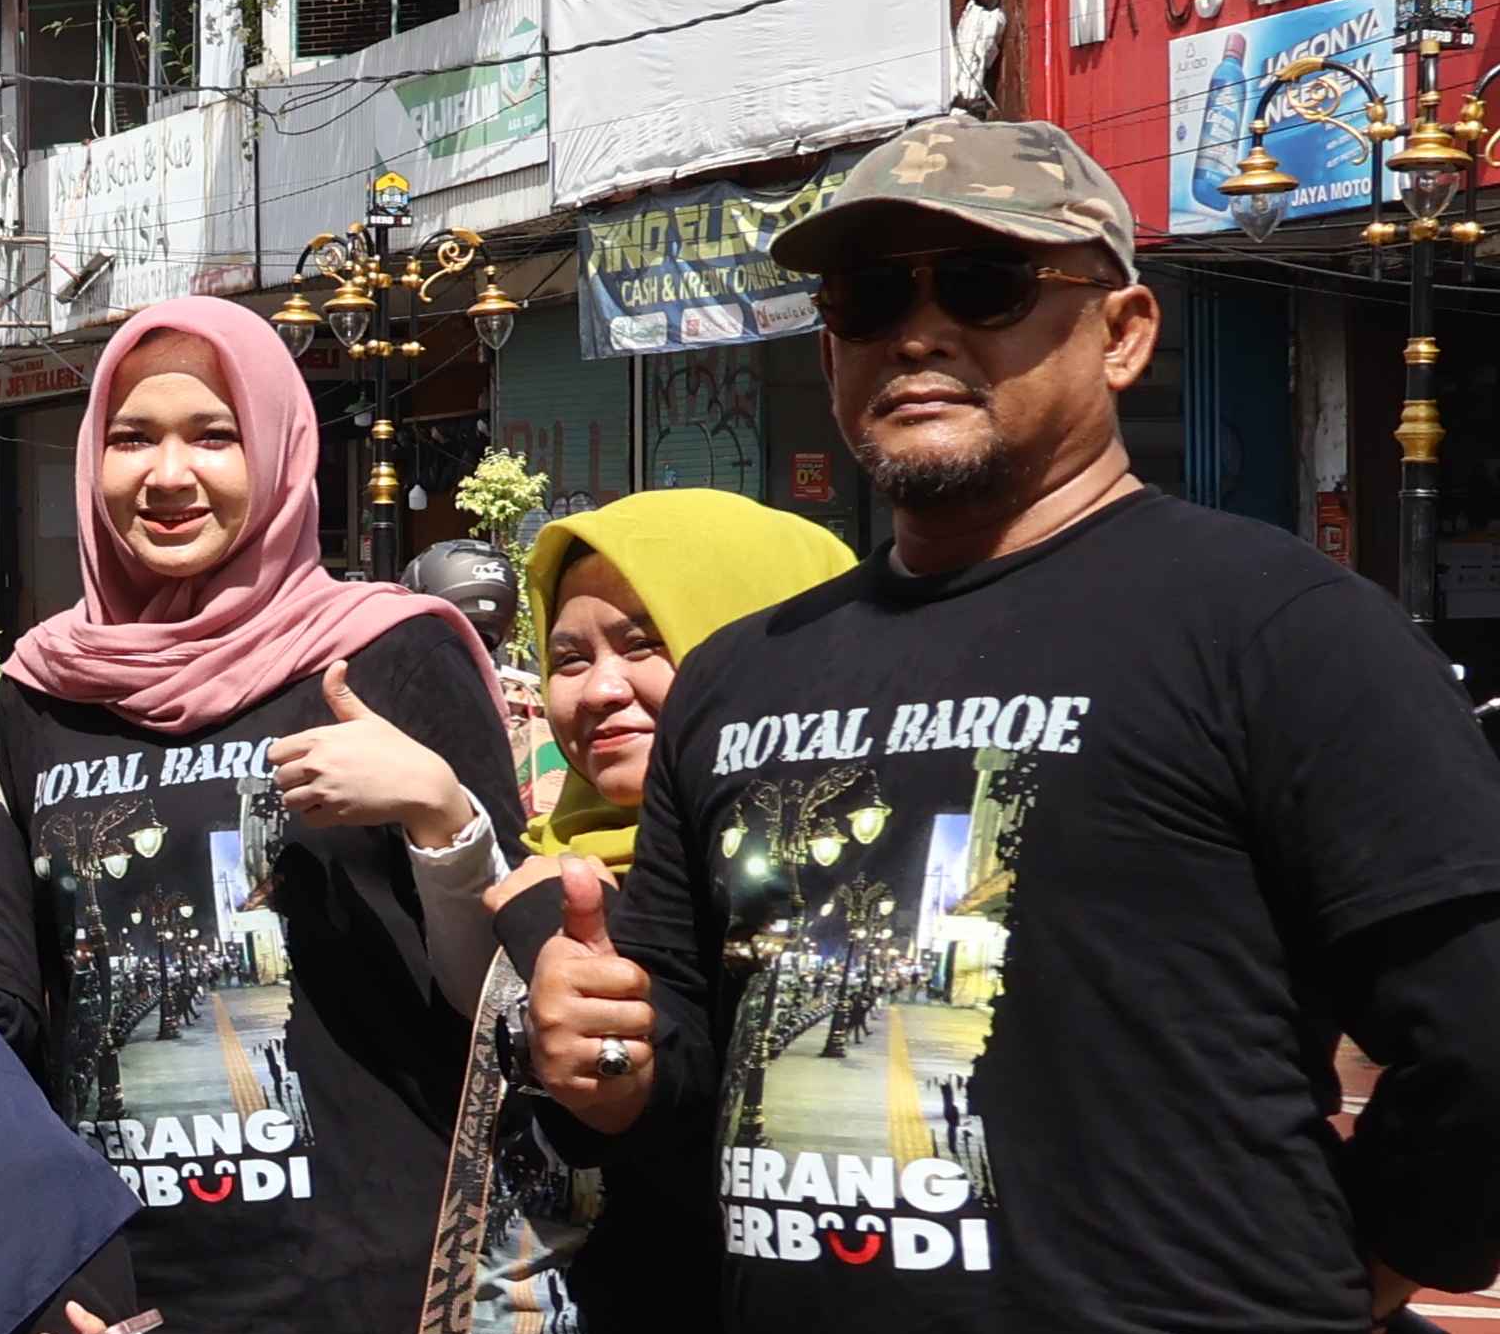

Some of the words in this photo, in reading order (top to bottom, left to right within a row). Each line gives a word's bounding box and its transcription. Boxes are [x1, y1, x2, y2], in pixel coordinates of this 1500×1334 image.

[163, 122, 193, 172] Kue
[1290, 184, 1327, 208] JAYA
[1329, 176, 1374, 203] MOTO
[620, 281, 659, 308] CASH
[160, 736, 281, 789] BARO
[712, 707, 874, 777] ROYAL
[885, 695, 1090, 757] BAROE
[718, 1144, 973, 1215] SERANG
[722, 1210, 992, 1271] ERBUDI
